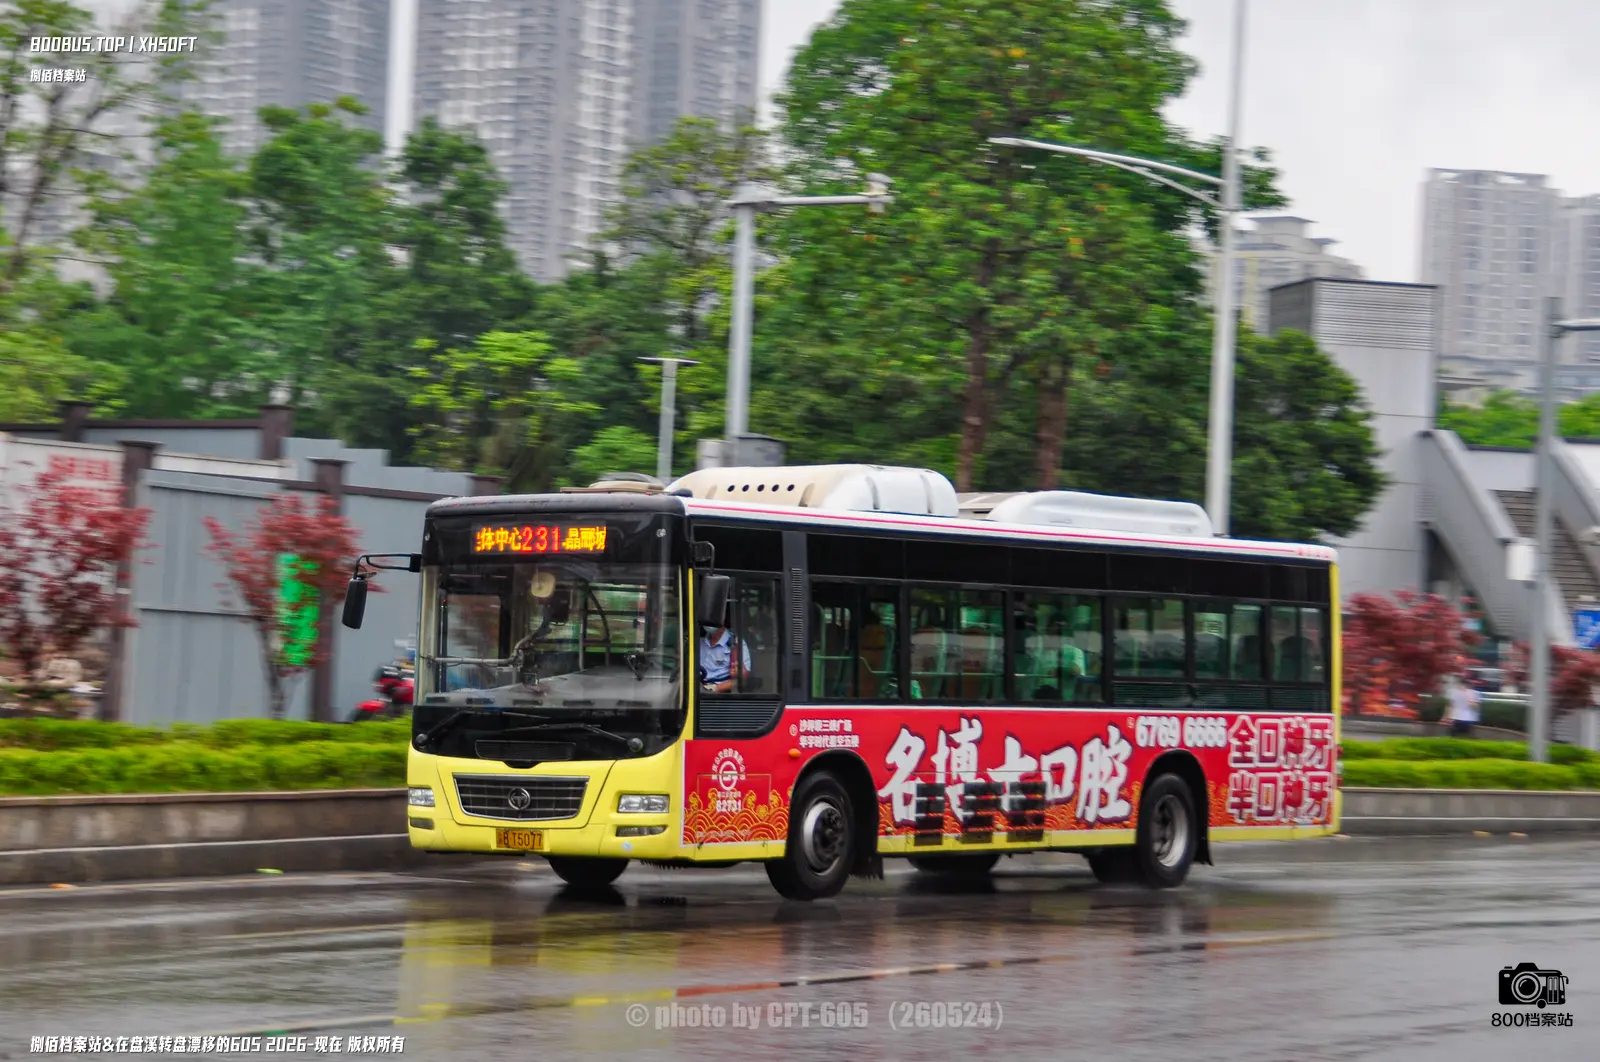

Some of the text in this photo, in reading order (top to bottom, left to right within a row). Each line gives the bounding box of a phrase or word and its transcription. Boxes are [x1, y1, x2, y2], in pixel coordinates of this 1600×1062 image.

[521, 525, 560, 553] 231
[1183, 716, 1228, 748] 6666
[877, 715, 1133, 824] 名博士口腔
